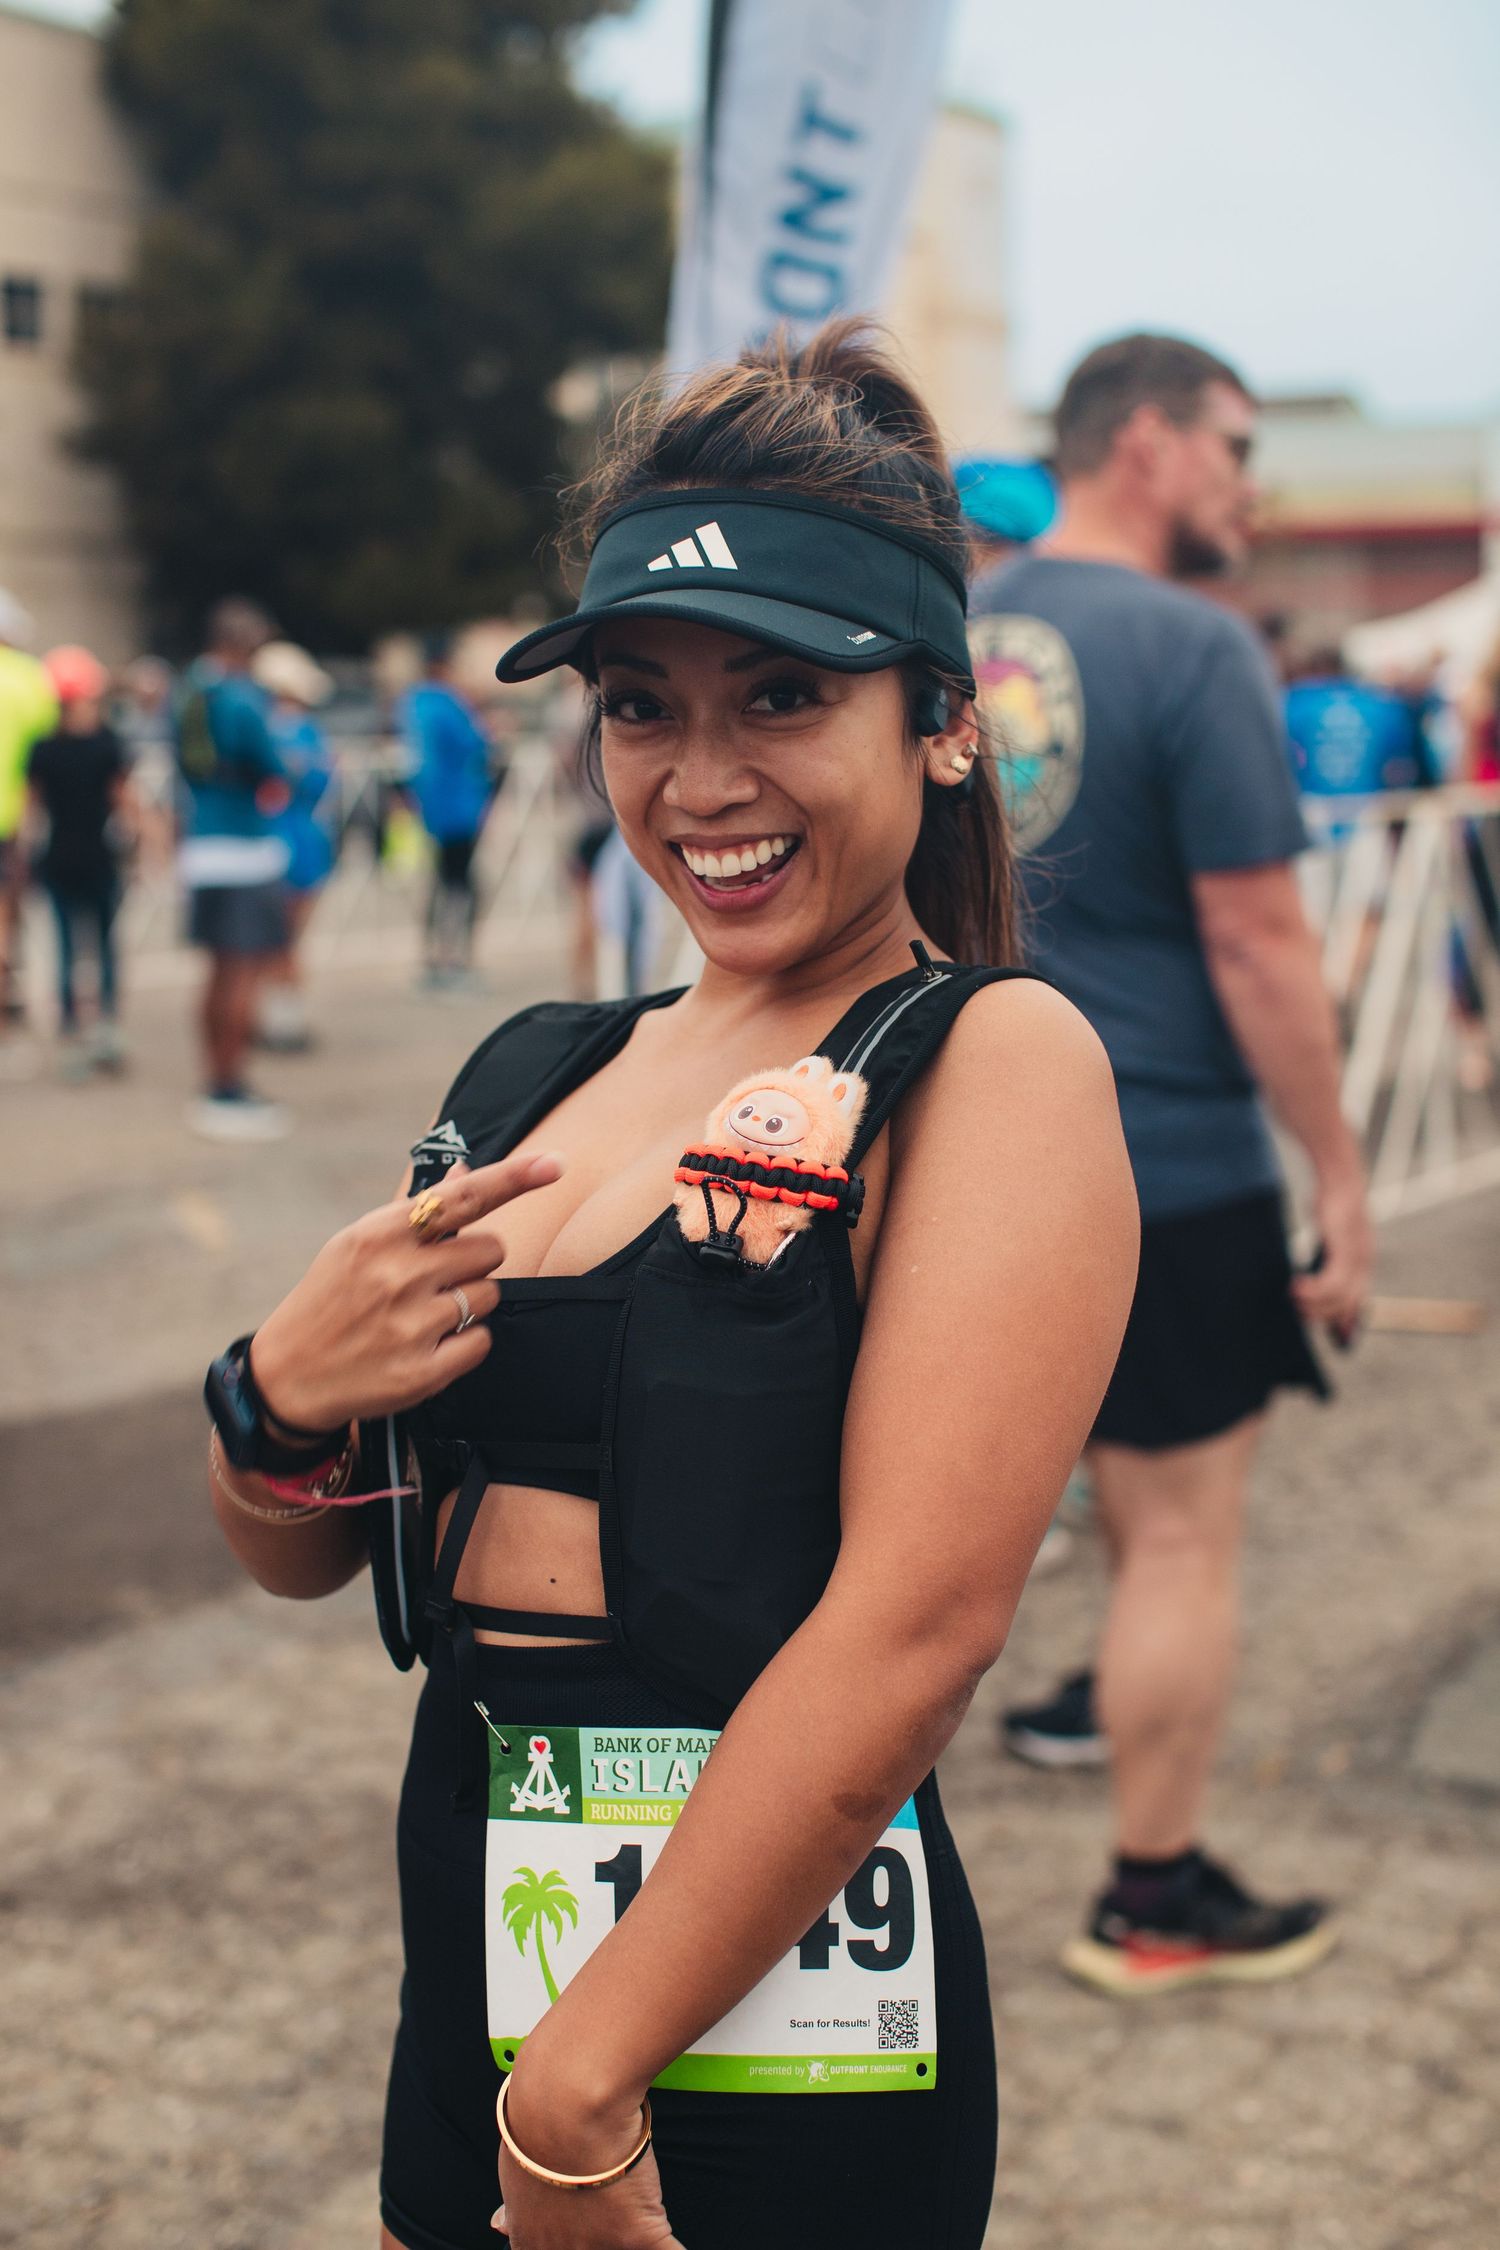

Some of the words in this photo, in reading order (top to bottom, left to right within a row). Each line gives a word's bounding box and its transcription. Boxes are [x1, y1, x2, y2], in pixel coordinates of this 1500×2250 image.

[757, 78, 862, 345] ONT
[593, 1737, 642, 1753] BANK
[646, 1737, 672, 1753] OF
[591, 1802, 673, 1821] RUNNING
[789, 2018, 814, 2029] Scan
[816, 2018, 831, 2028] for
[833, 2018, 871, 2028] Results!
[749, 2064, 792, 2077] presented
[795, 2064, 805, 2078] by
[830, 2064, 869, 2075] OUTFRONT
[869, 2063, 909, 2074] ENDURANCE
